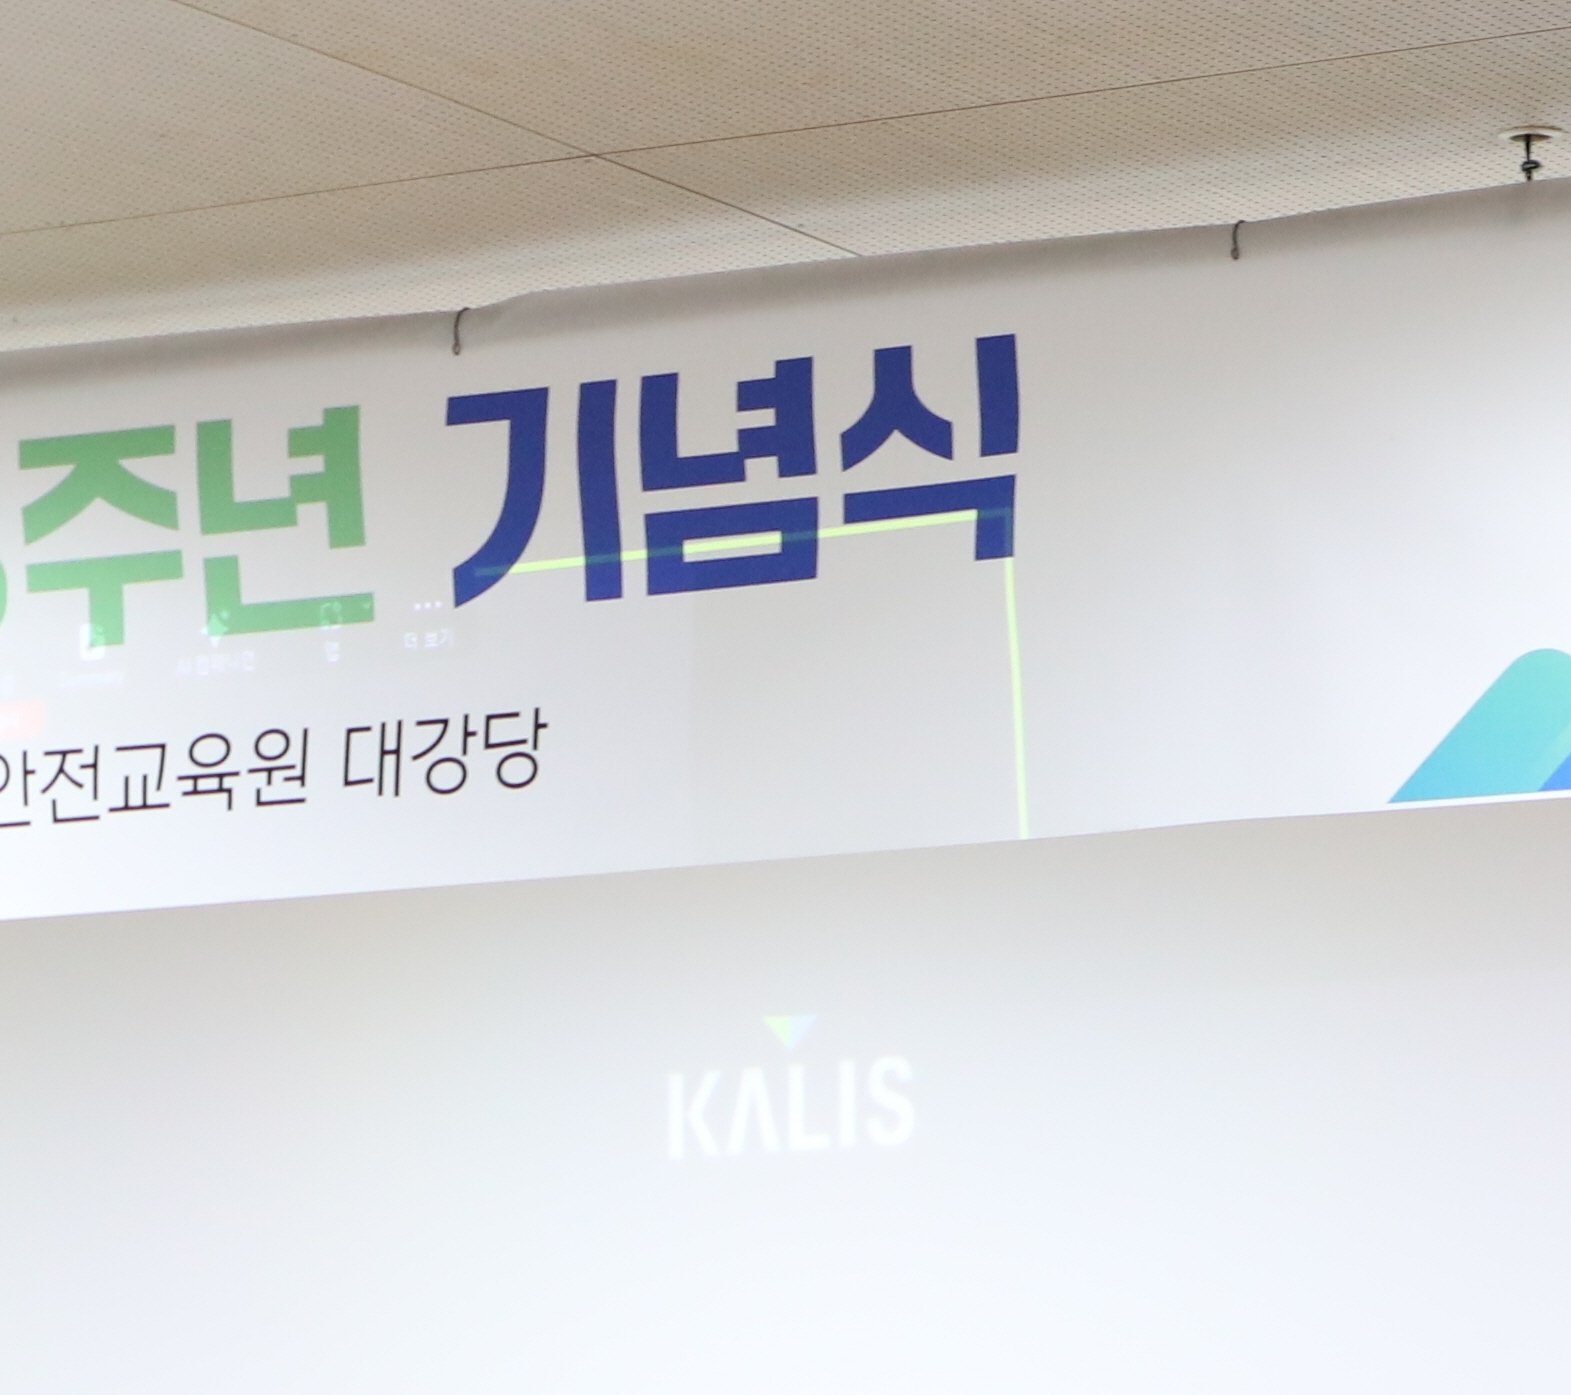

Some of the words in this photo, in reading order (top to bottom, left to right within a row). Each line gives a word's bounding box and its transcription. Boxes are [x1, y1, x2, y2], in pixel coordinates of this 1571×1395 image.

[447, 333, 1020, 607] 기념식
[342, 706, 550, 799] 대강당
[666, 1054, 917, 1160] KALIS
